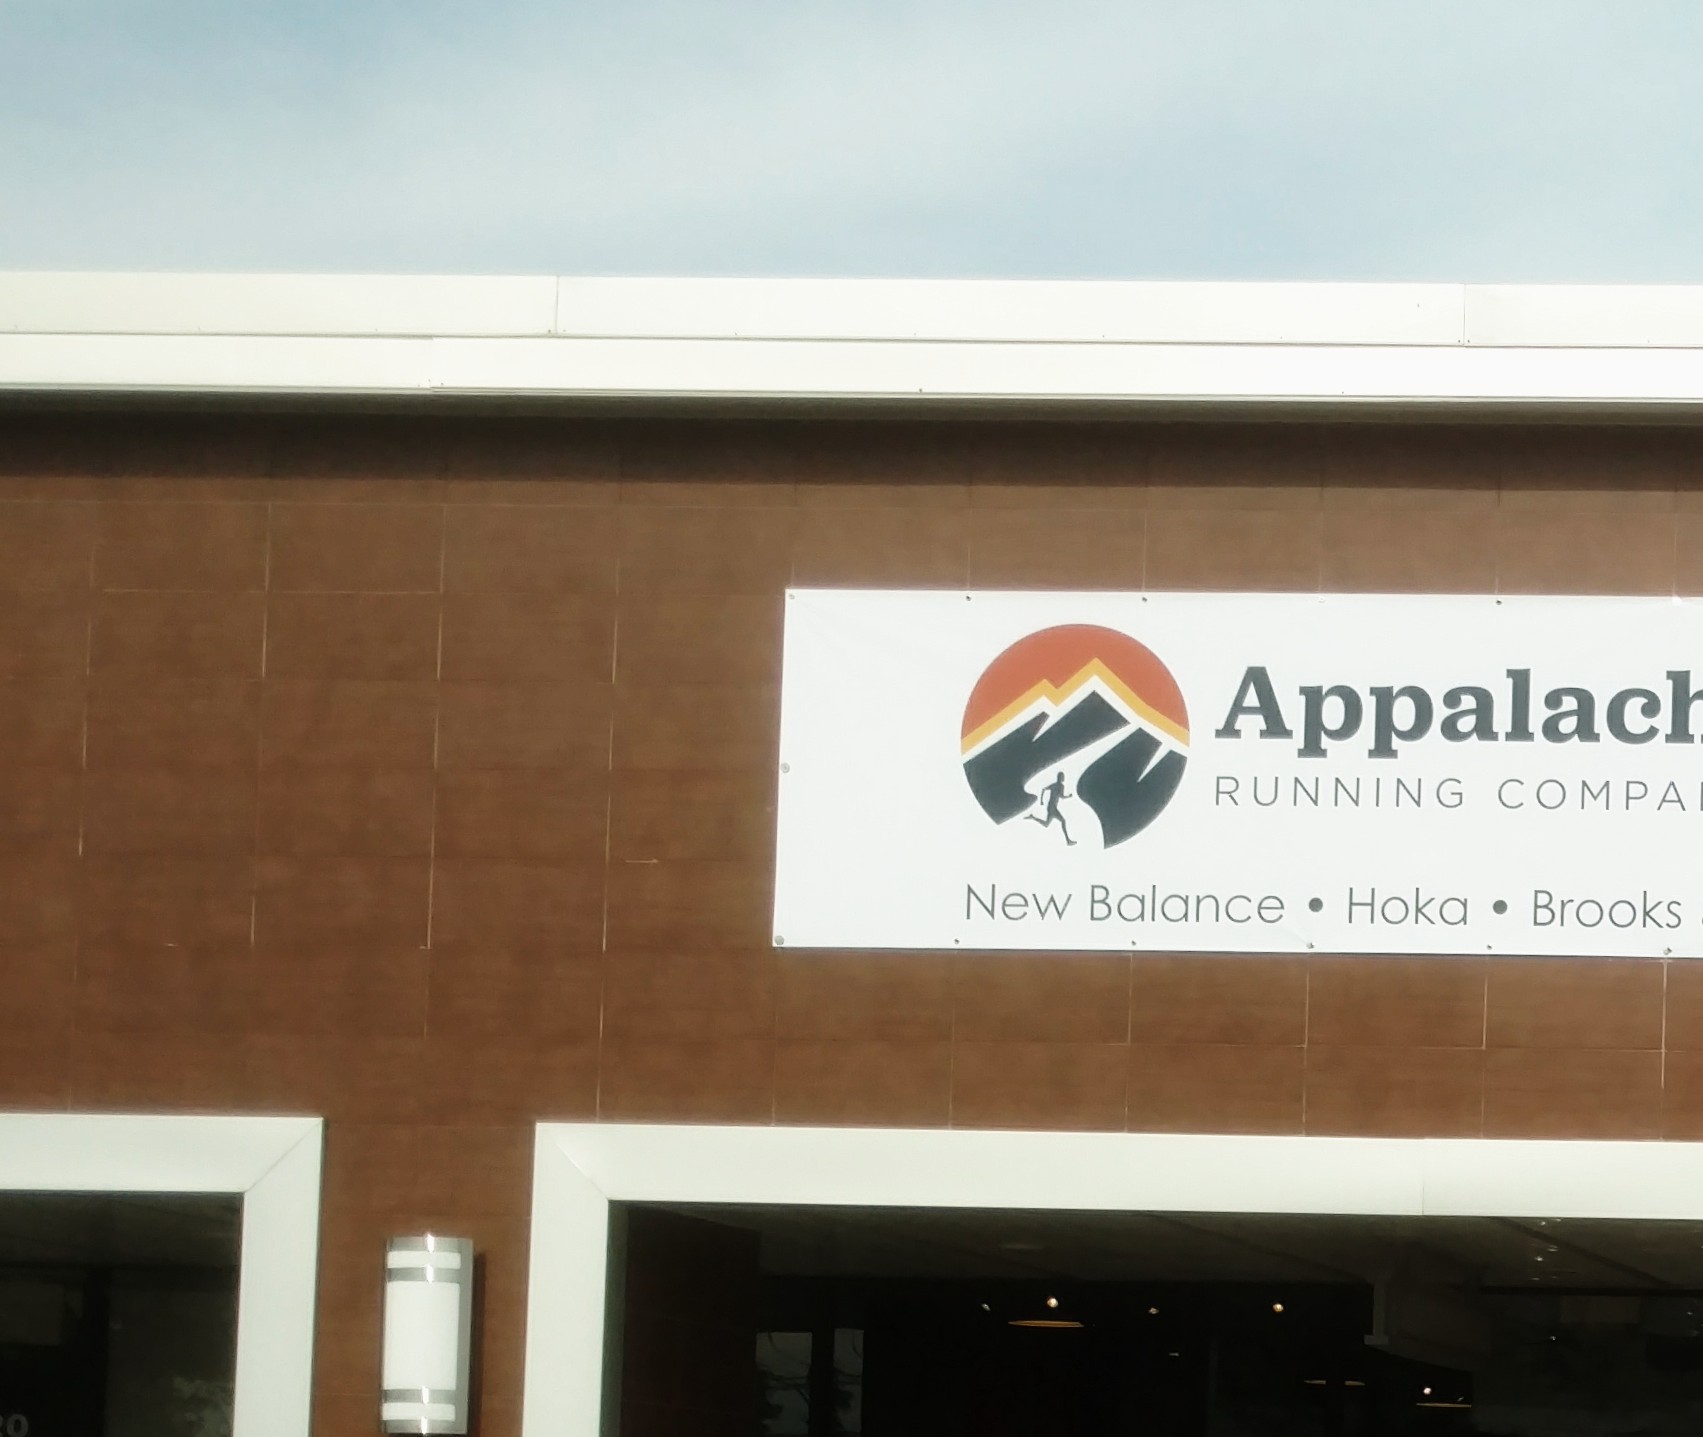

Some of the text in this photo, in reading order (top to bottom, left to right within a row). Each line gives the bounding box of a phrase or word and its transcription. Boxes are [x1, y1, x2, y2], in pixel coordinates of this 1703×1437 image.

[1216, 776, 1463, 808] RUNNING
[966, 884, 1072, 920] New
[1091, 885, 1285, 923] Balance
[1349, 888, 1468, 925] Hoka
[1533, 890, 1682, 928] Brooks
